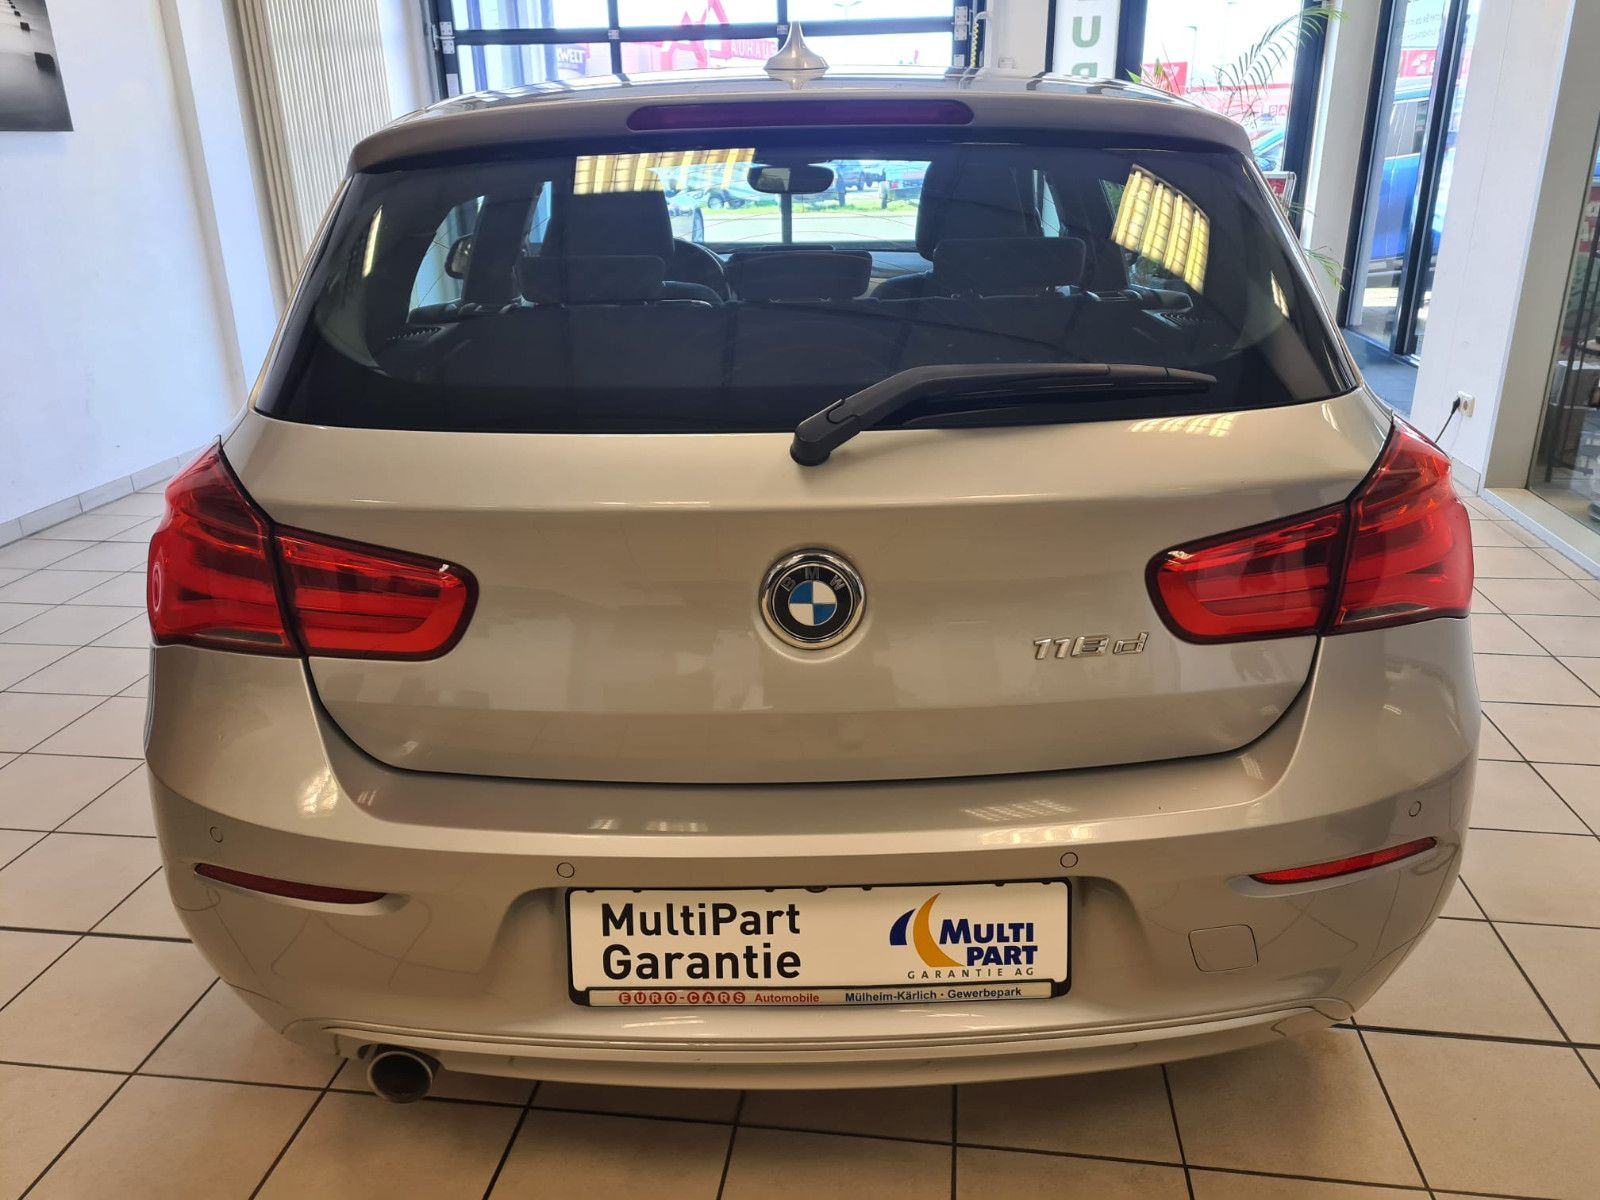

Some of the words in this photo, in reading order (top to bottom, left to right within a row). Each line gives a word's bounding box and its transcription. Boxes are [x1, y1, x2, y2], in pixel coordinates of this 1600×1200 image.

[780, 567, 846, 592] BMW
[601, 903, 800, 936] MultiPart
[602, 942, 801, 980] Garantie
[966, 945, 1038, 967] PART
[907, 967, 1003, 979] GARANTIE
[1015, 967, 1034, 976] AG
[618, 991, 746, 1004] EURO-CARS
[754, 992, 820, 1004] Automobile
[845, 990, 937, 1002] Mülheim-Kärlich
[947, 987, 1022, 999] Gewerbepark
